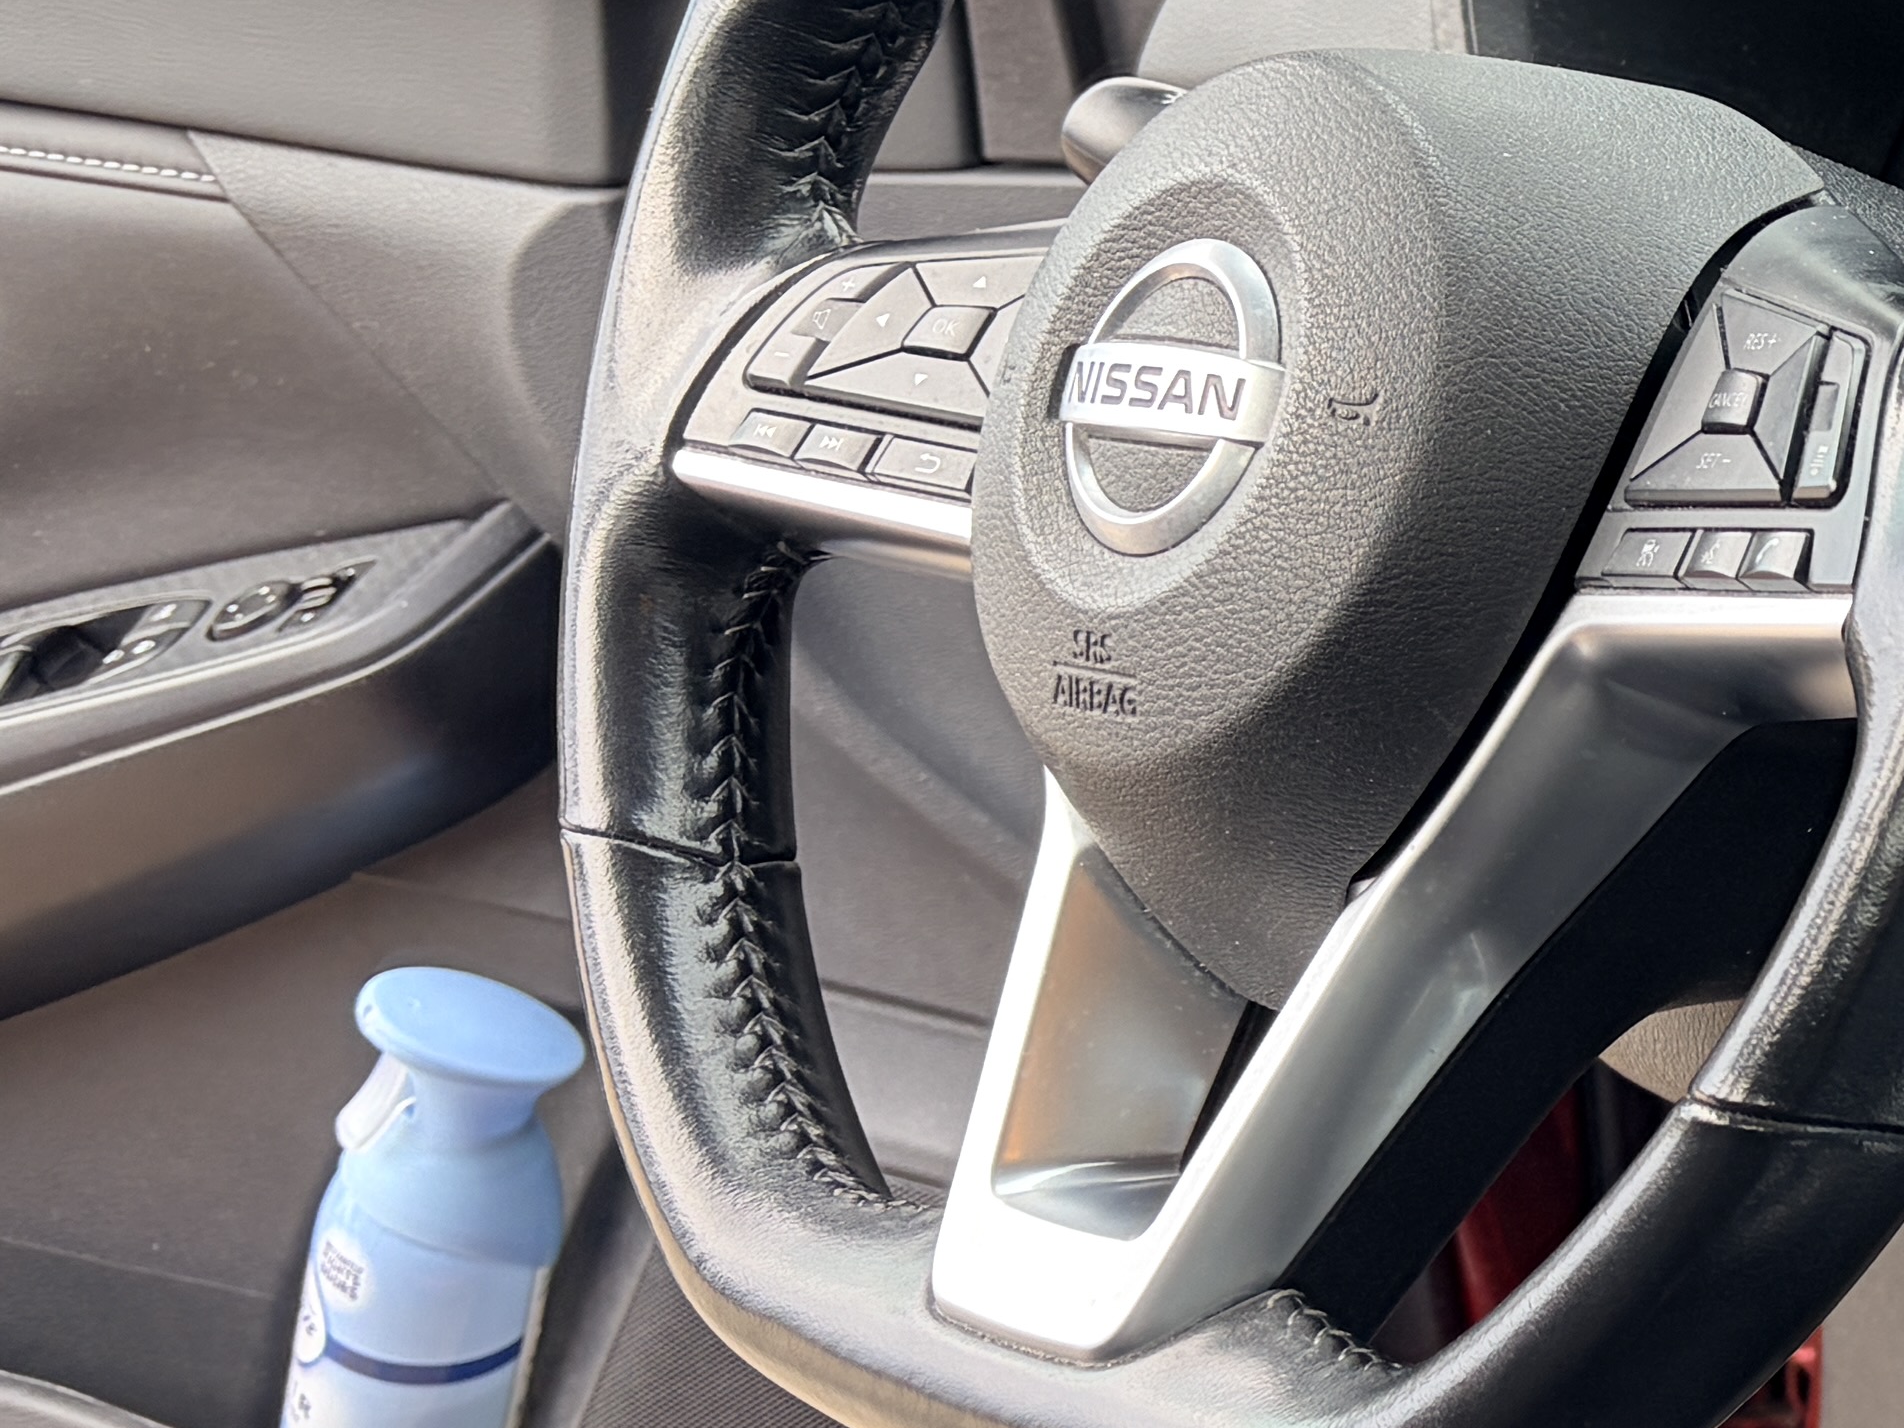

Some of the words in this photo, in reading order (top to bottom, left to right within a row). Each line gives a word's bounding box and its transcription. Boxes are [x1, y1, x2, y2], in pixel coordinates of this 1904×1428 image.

[931, 317, 961, 338] OK
[1068, 361, 1247, 421] NISSAN
[1708, 391, 1749, 409] CANCEL
[1072, 629, 1112, 664] SRS
[1052, 674, 1138, 717] AIRBAG
